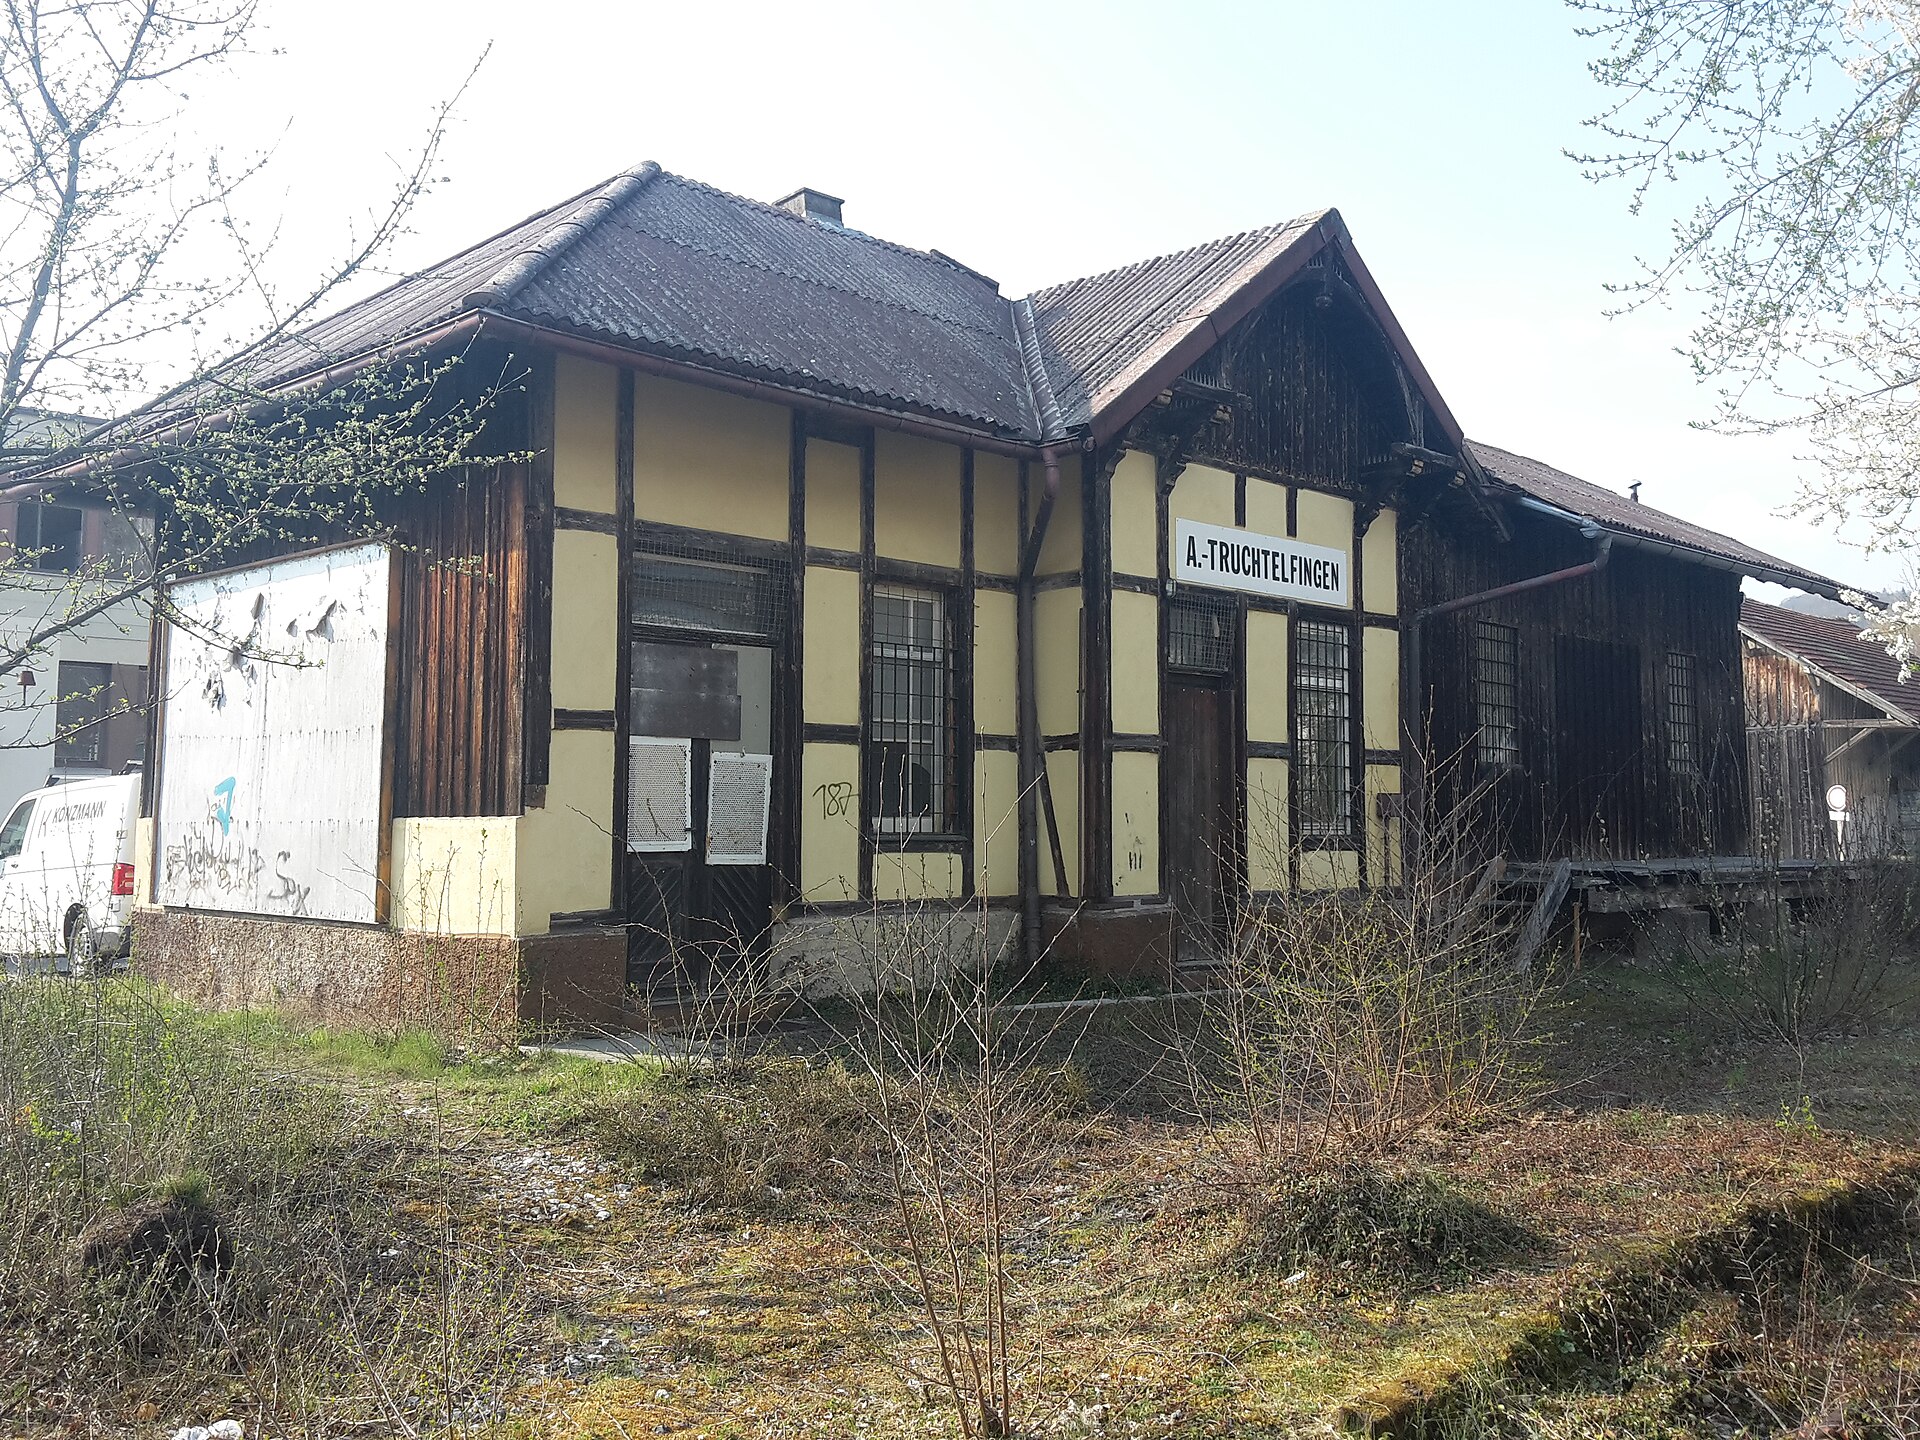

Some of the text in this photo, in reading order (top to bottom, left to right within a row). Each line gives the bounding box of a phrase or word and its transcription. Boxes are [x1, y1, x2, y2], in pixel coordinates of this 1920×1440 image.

[1186, 535, 1340, 592] A.-TRUCHTELFINGEN
[52, 800, 107, 824] KONZMANN
[812, 781, 859, 820] 187
